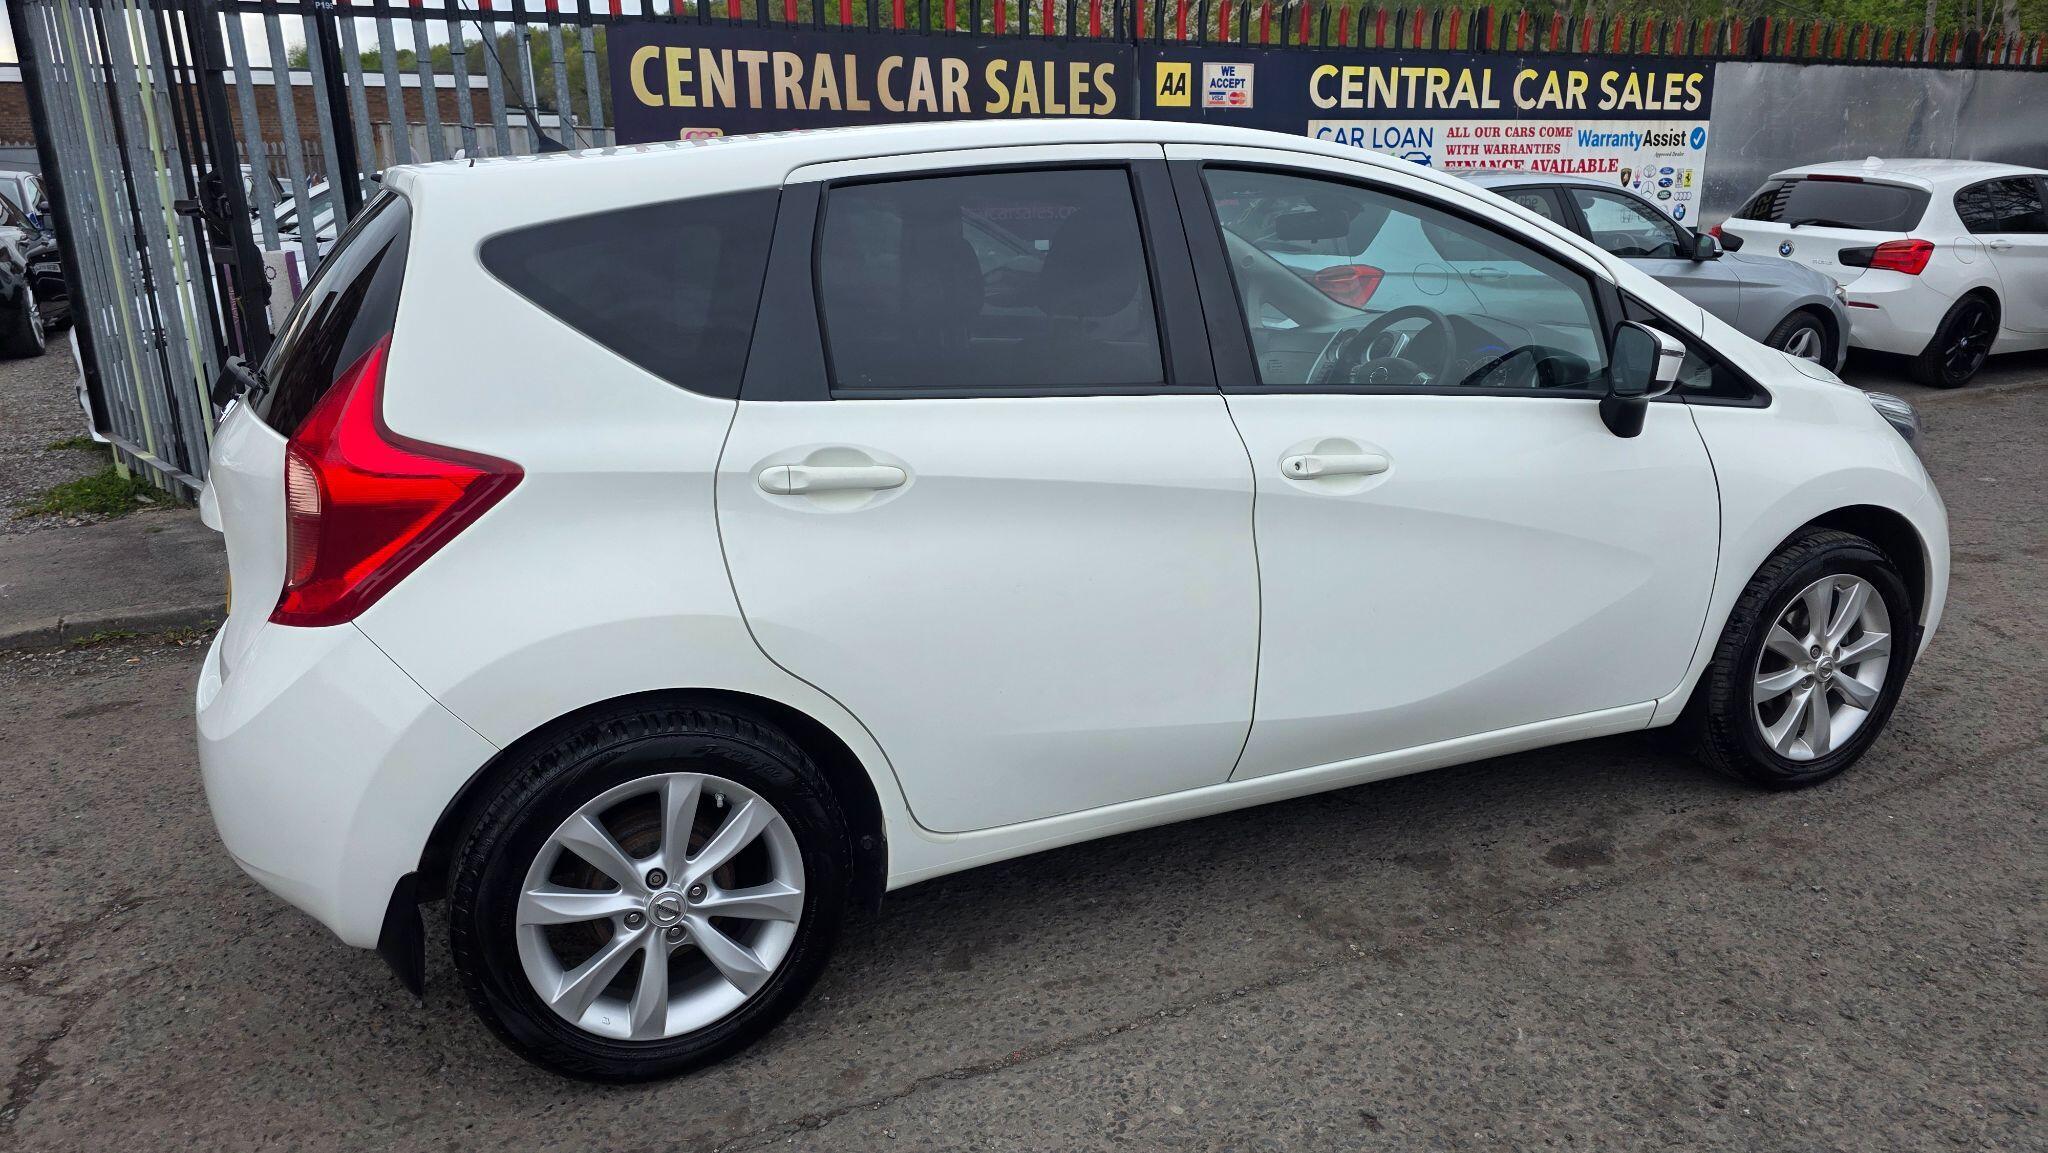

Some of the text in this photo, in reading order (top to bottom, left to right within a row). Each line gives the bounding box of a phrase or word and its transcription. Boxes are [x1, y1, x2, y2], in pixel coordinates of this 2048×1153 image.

[1221, 66, 1235, 77] WE
[630, 45, 1117, 116] CENTRAL CAR SALES
[1160, 72, 1186, 96] AA
[1210, 78, 1246, 89] ACCEPT
[1309, 64, 1704, 112] CENTRAL CAR SALES
[1373, 127, 1433, 148] LOAN
[1447, 127, 1573, 138] ALL OUR CARS COME
[1446, 144, 1561, 155] WITH WARRANTIES
[1531, 158, 1619, 173] AVAILABLE
